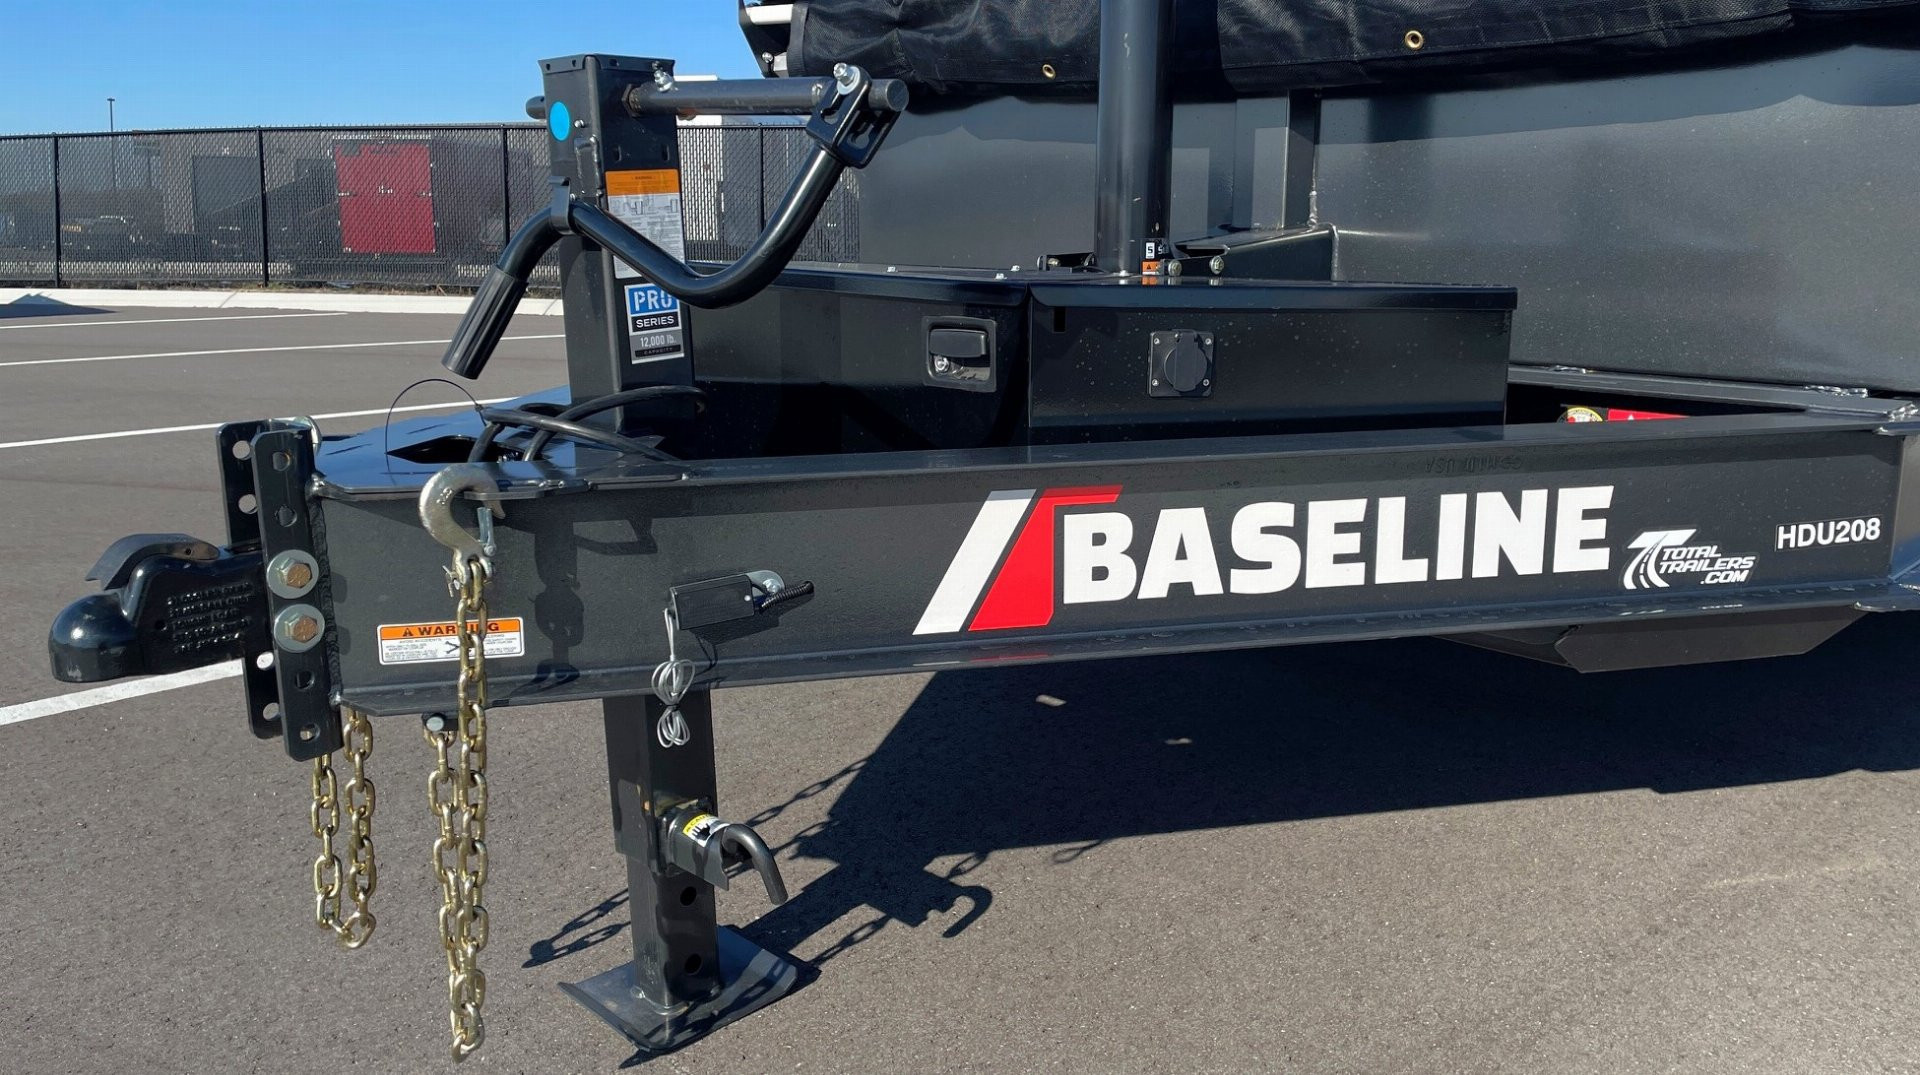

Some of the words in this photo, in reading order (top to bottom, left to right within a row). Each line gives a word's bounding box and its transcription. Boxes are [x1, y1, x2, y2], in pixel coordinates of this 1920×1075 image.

[636, 315, 675, 328] SERIES
[640, 335, 666, 348] 12,000
[1777, 517, 1882, 550] HDU208
[1064, 486, 1615, 605] BASELINE
[1662, 545, 1722, 560] TOTAL
[1658, 556, 1756, 574] TRAILERS
[1700, 569, 1750, 585] .COM
